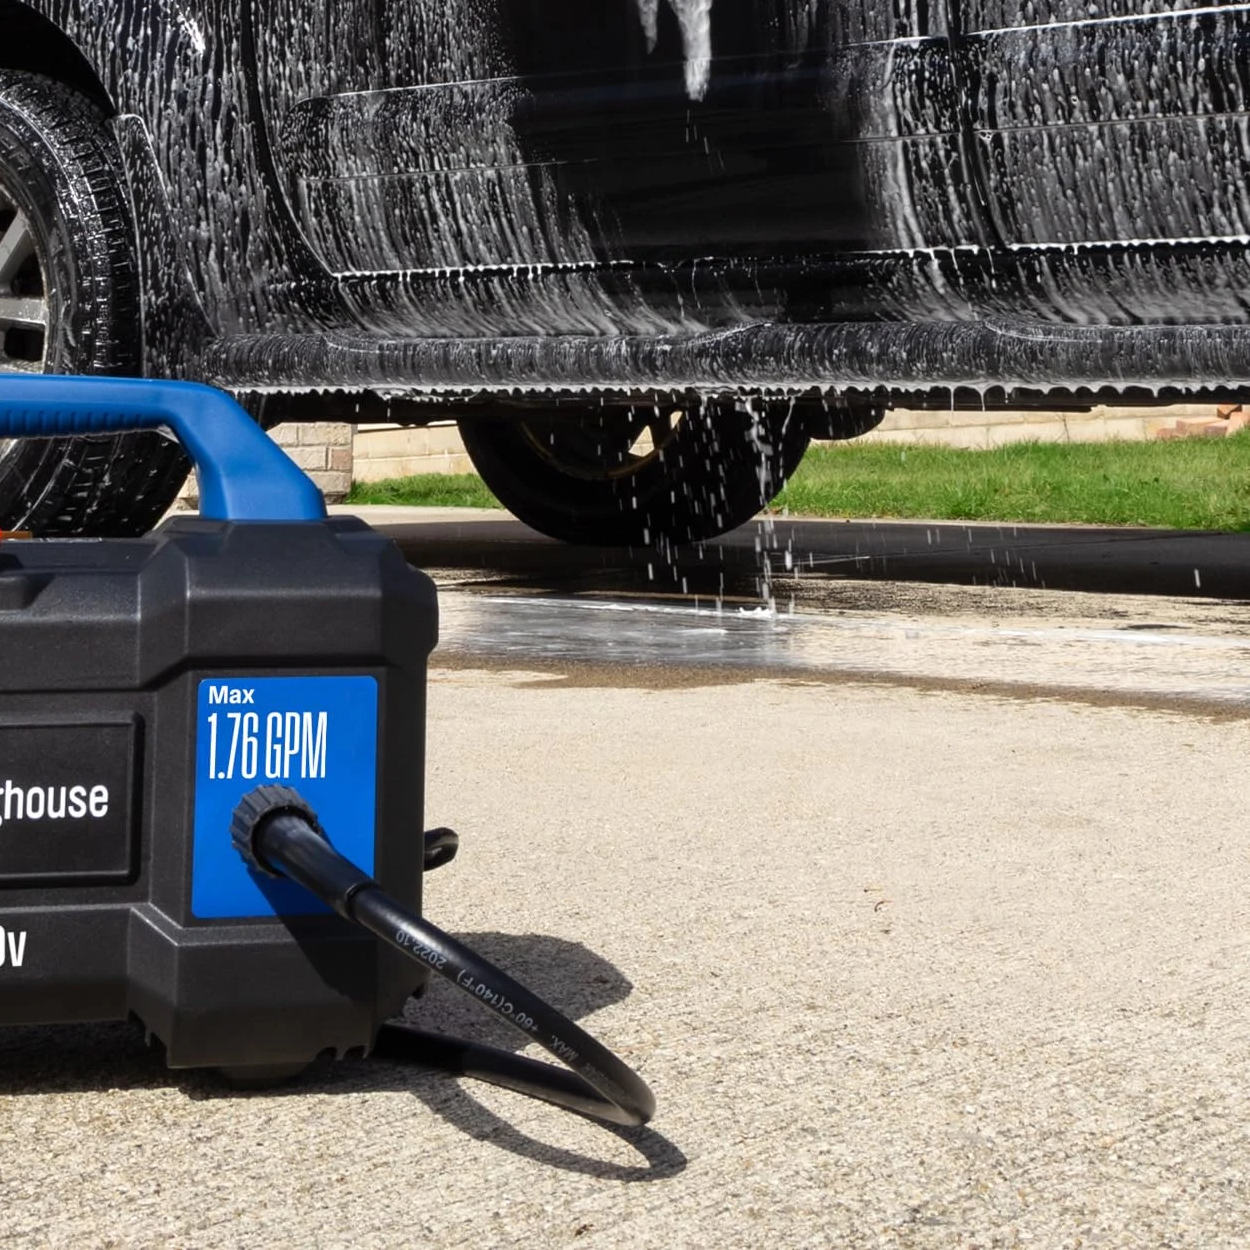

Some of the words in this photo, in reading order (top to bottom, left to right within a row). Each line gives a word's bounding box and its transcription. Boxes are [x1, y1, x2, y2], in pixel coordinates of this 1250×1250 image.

[208, 685, 255, 705] Max
[207, 711, 259, 780] 1.76
[264, 711, 328, 779] GPM
[395, 930, 448, 970] 2022.10
